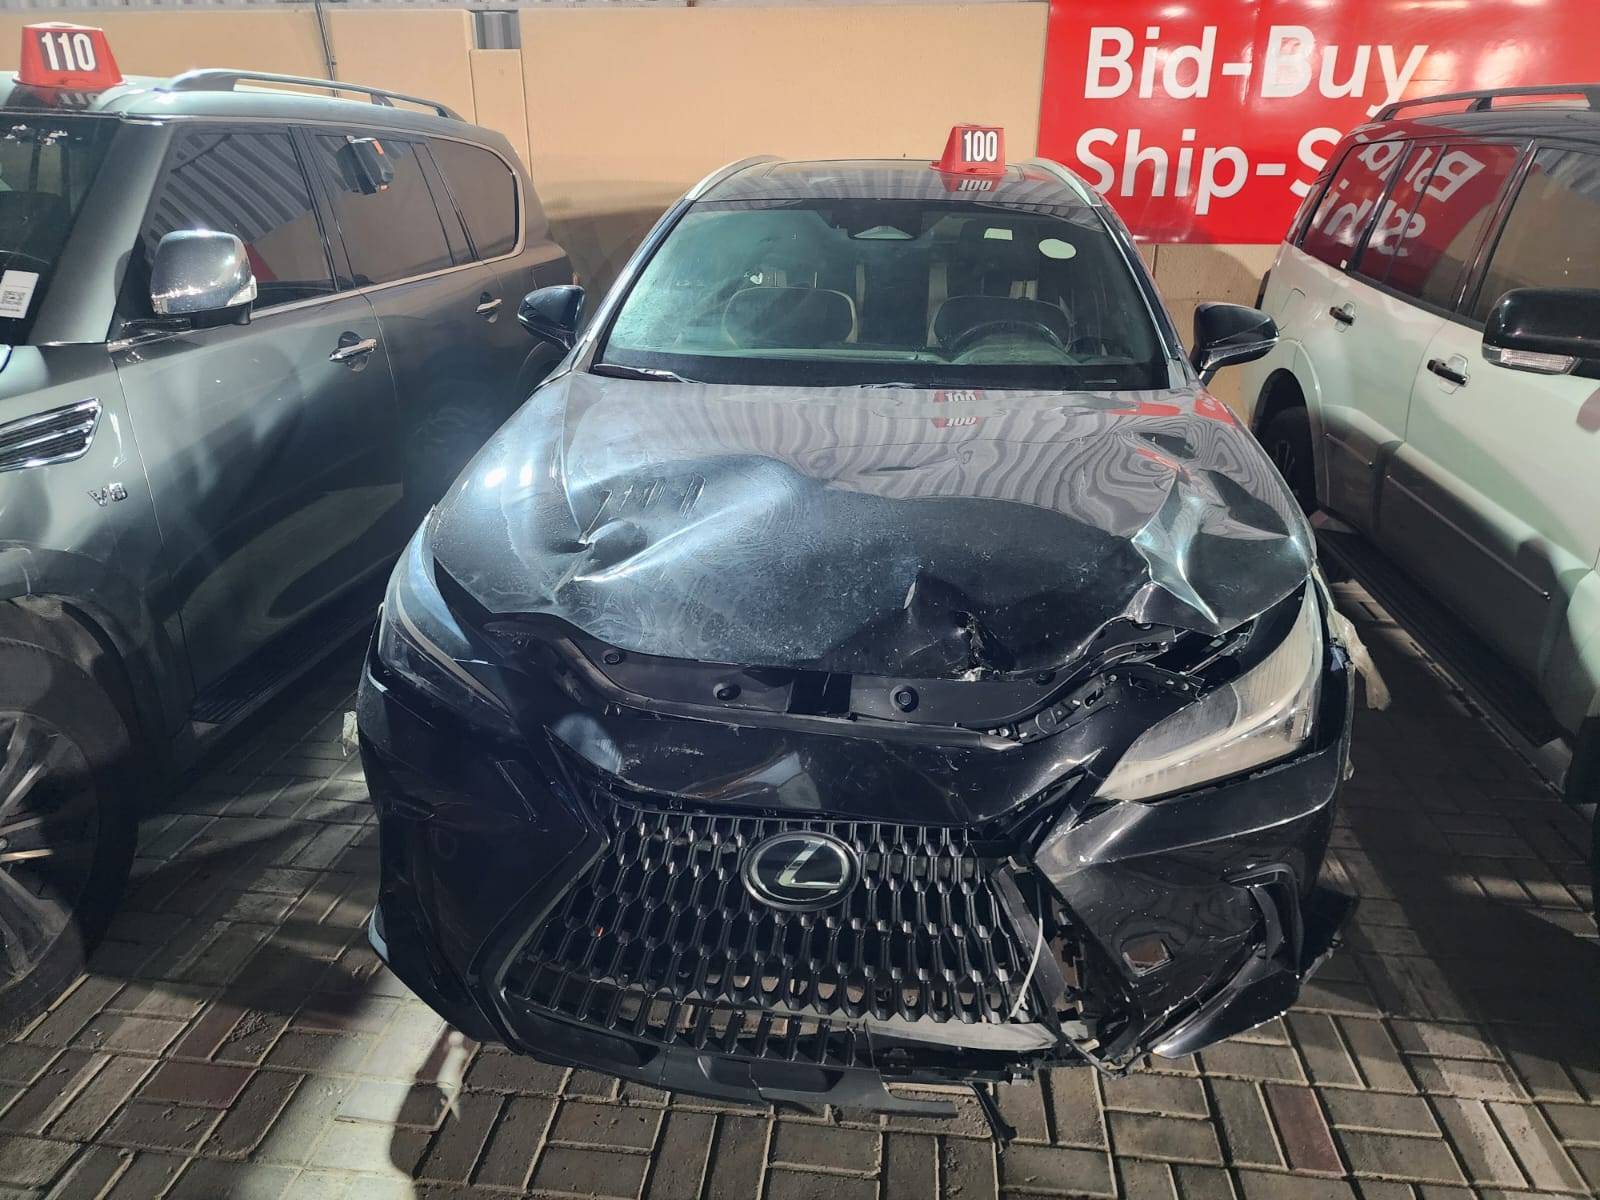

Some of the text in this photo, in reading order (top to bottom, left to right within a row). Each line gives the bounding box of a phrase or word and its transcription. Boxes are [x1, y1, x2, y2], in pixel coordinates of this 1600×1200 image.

[41, 32, 96, 71] 110
[1084, 25, 1430, 118] Bid-Buy
[964, 130, 998, 162] 100
